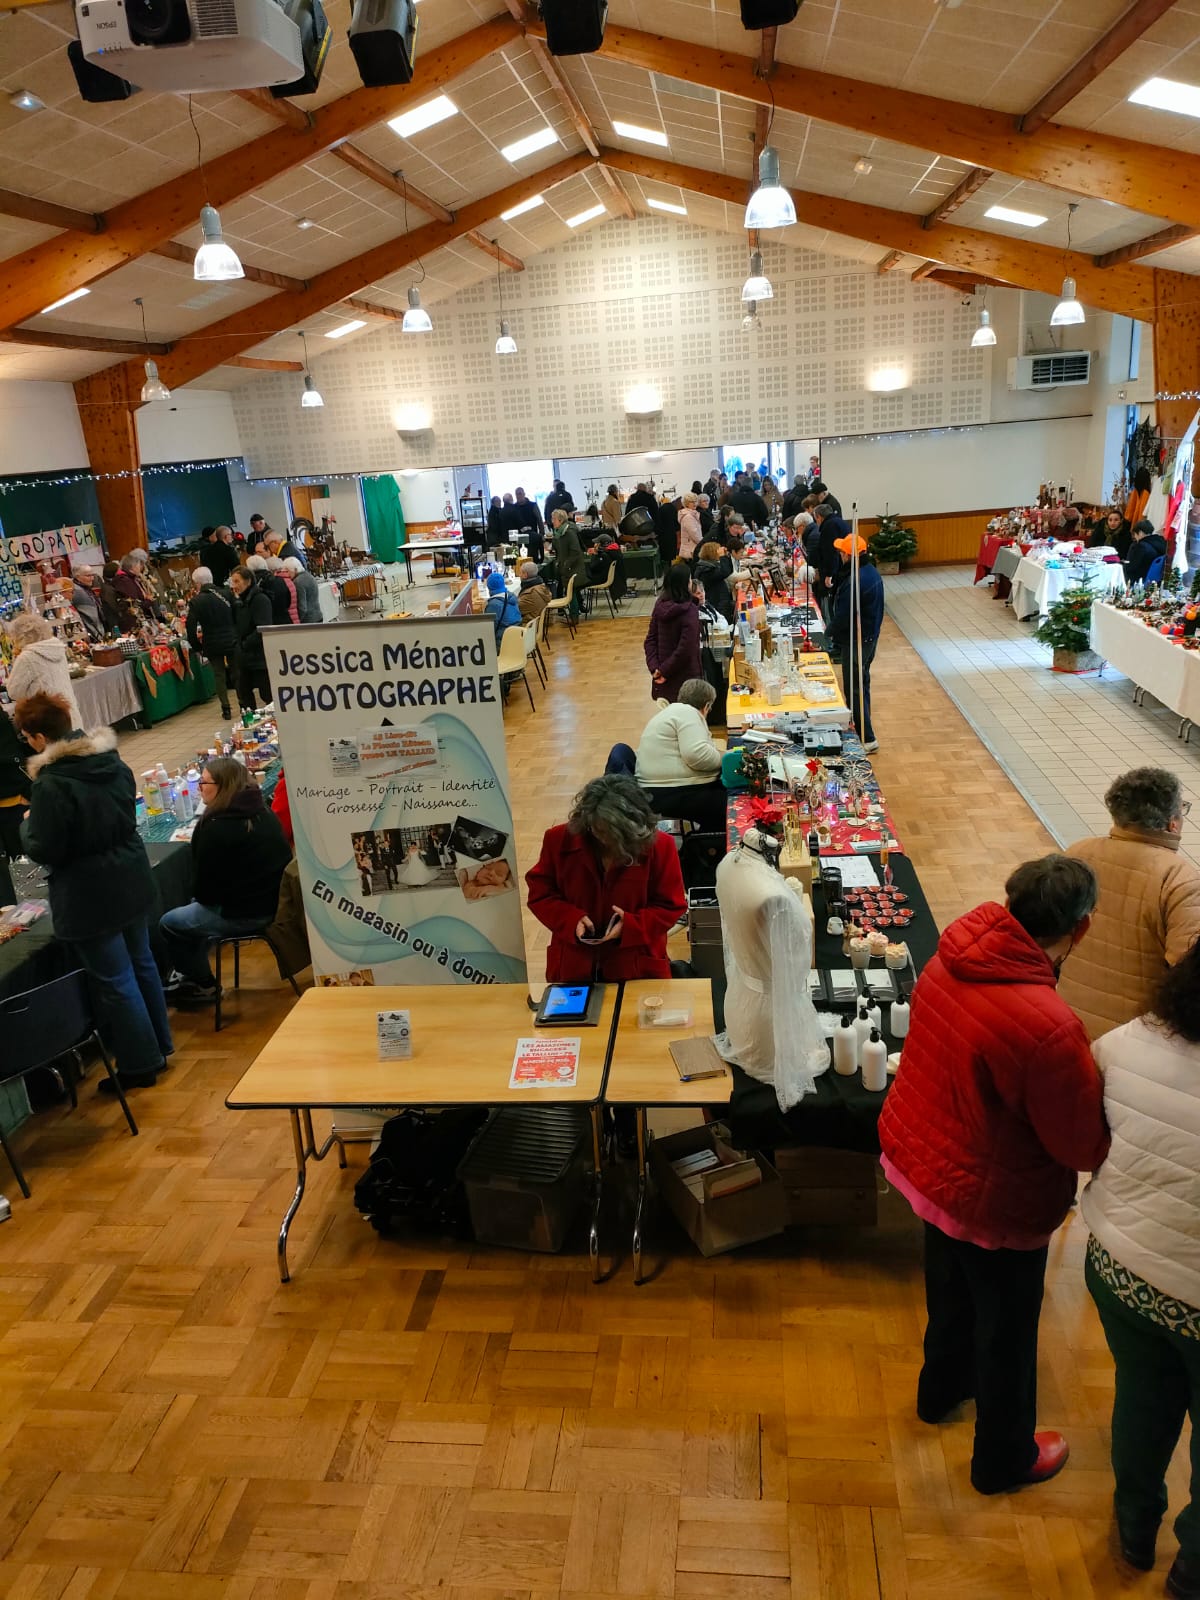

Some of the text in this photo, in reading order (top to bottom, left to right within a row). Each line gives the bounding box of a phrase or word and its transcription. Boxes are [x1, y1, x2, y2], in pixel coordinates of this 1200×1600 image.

[279, 638, 486, 676] Jessica Ménard
[277, 676, 497, 713] PHOTOGRAPHE
[296, 786, 351, 800] Mariage
[369, 783, 424, 796] Portrait
[442, 778, 496, 792] Identité
[326, 802, 385, 814] Grossesse
[403, 797, 478, 810] Naissance...
[311, 879, 510, 984] En magasin ou à domi
